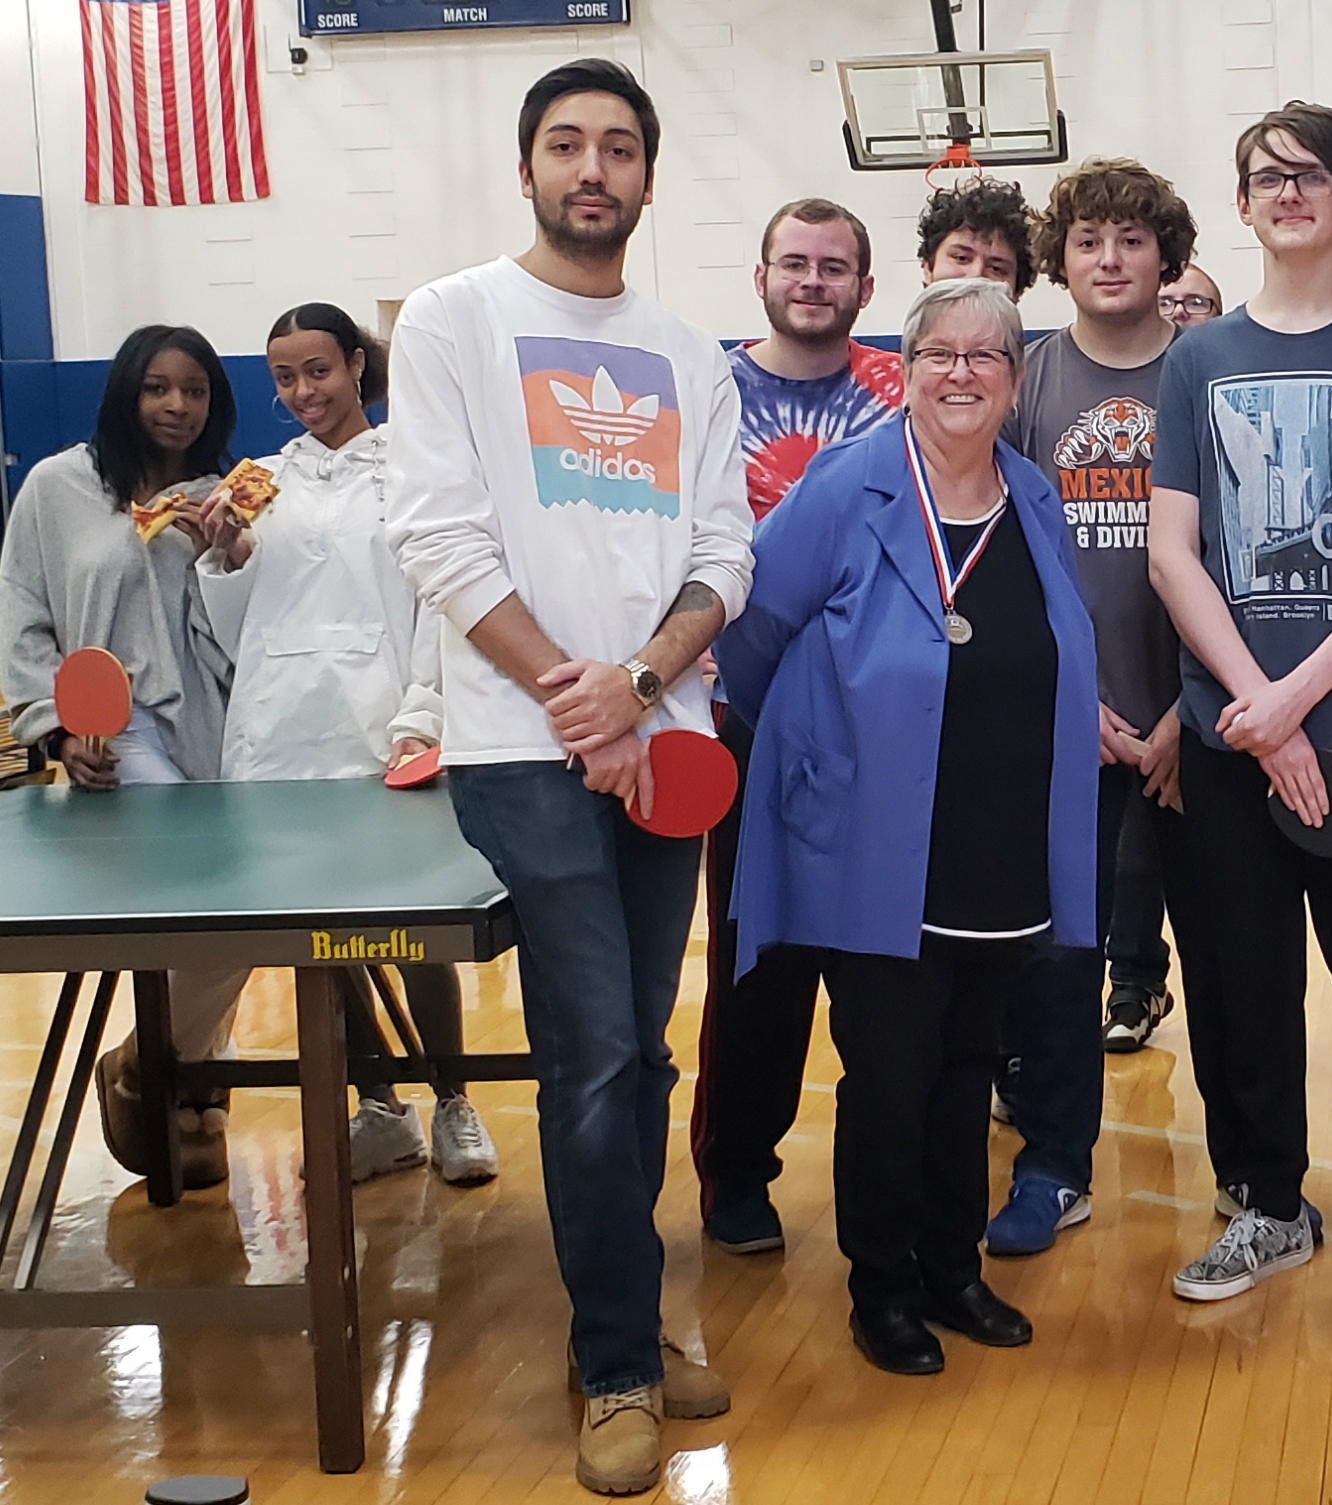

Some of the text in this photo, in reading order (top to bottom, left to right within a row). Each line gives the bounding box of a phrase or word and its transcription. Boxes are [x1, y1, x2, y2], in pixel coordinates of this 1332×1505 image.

[443, 7, 487, 23] MATCH
[567, 2, 609, 18] SCORE
[317, 13, 358, 29] SCORE
[559, 447, 656, 484] adidas
[1076, 525, 1150, 549] & DIVI
[311, 928, 425, 962] Butterfly
